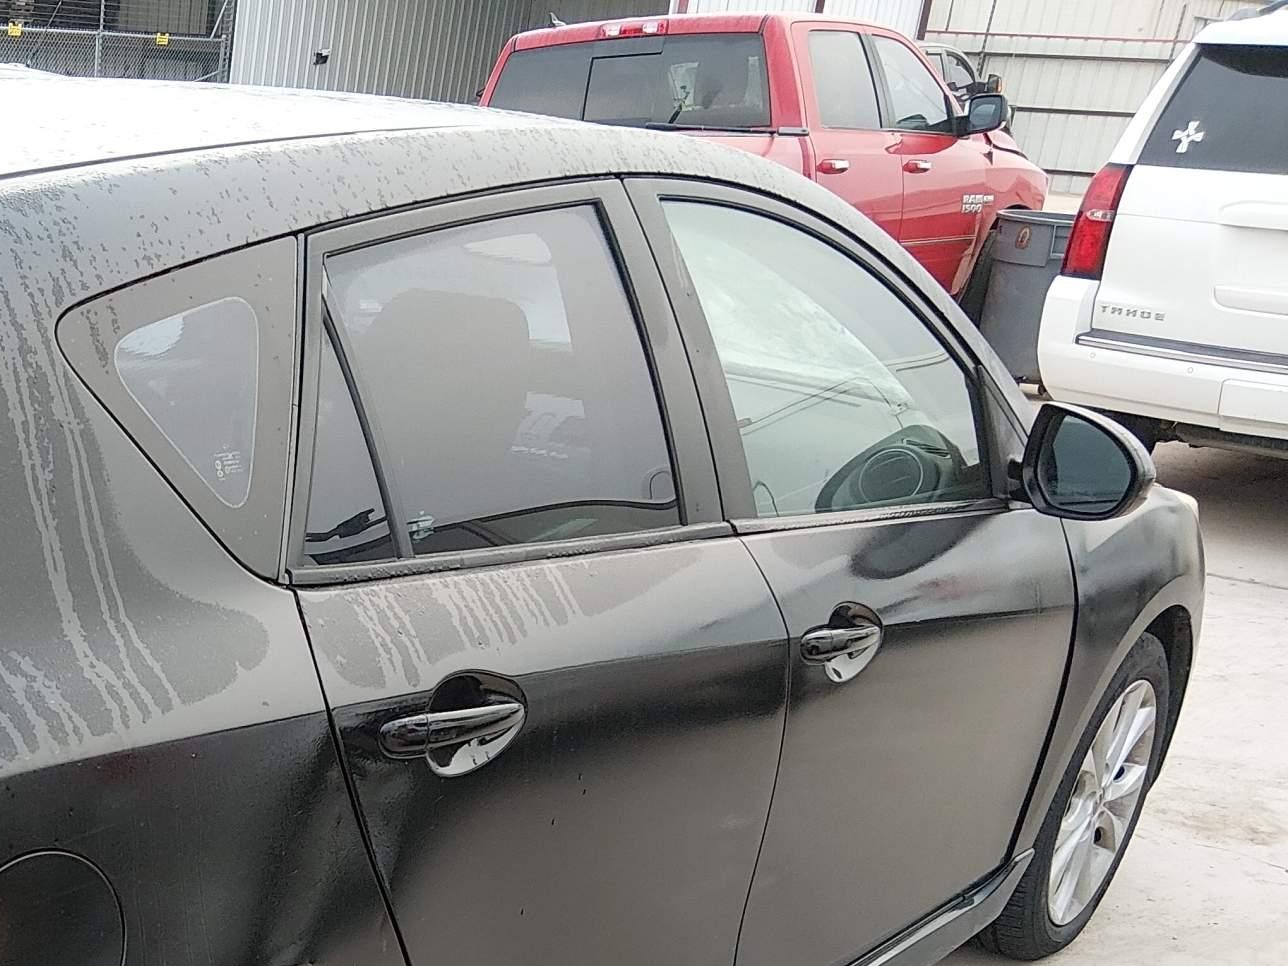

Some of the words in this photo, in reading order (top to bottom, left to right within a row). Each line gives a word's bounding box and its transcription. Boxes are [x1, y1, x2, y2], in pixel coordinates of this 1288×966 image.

[962, 194, 983, 204] RAM
[961, 204, 982, 214] 1500
[1100, 305, 1166, 321] TAHOE
